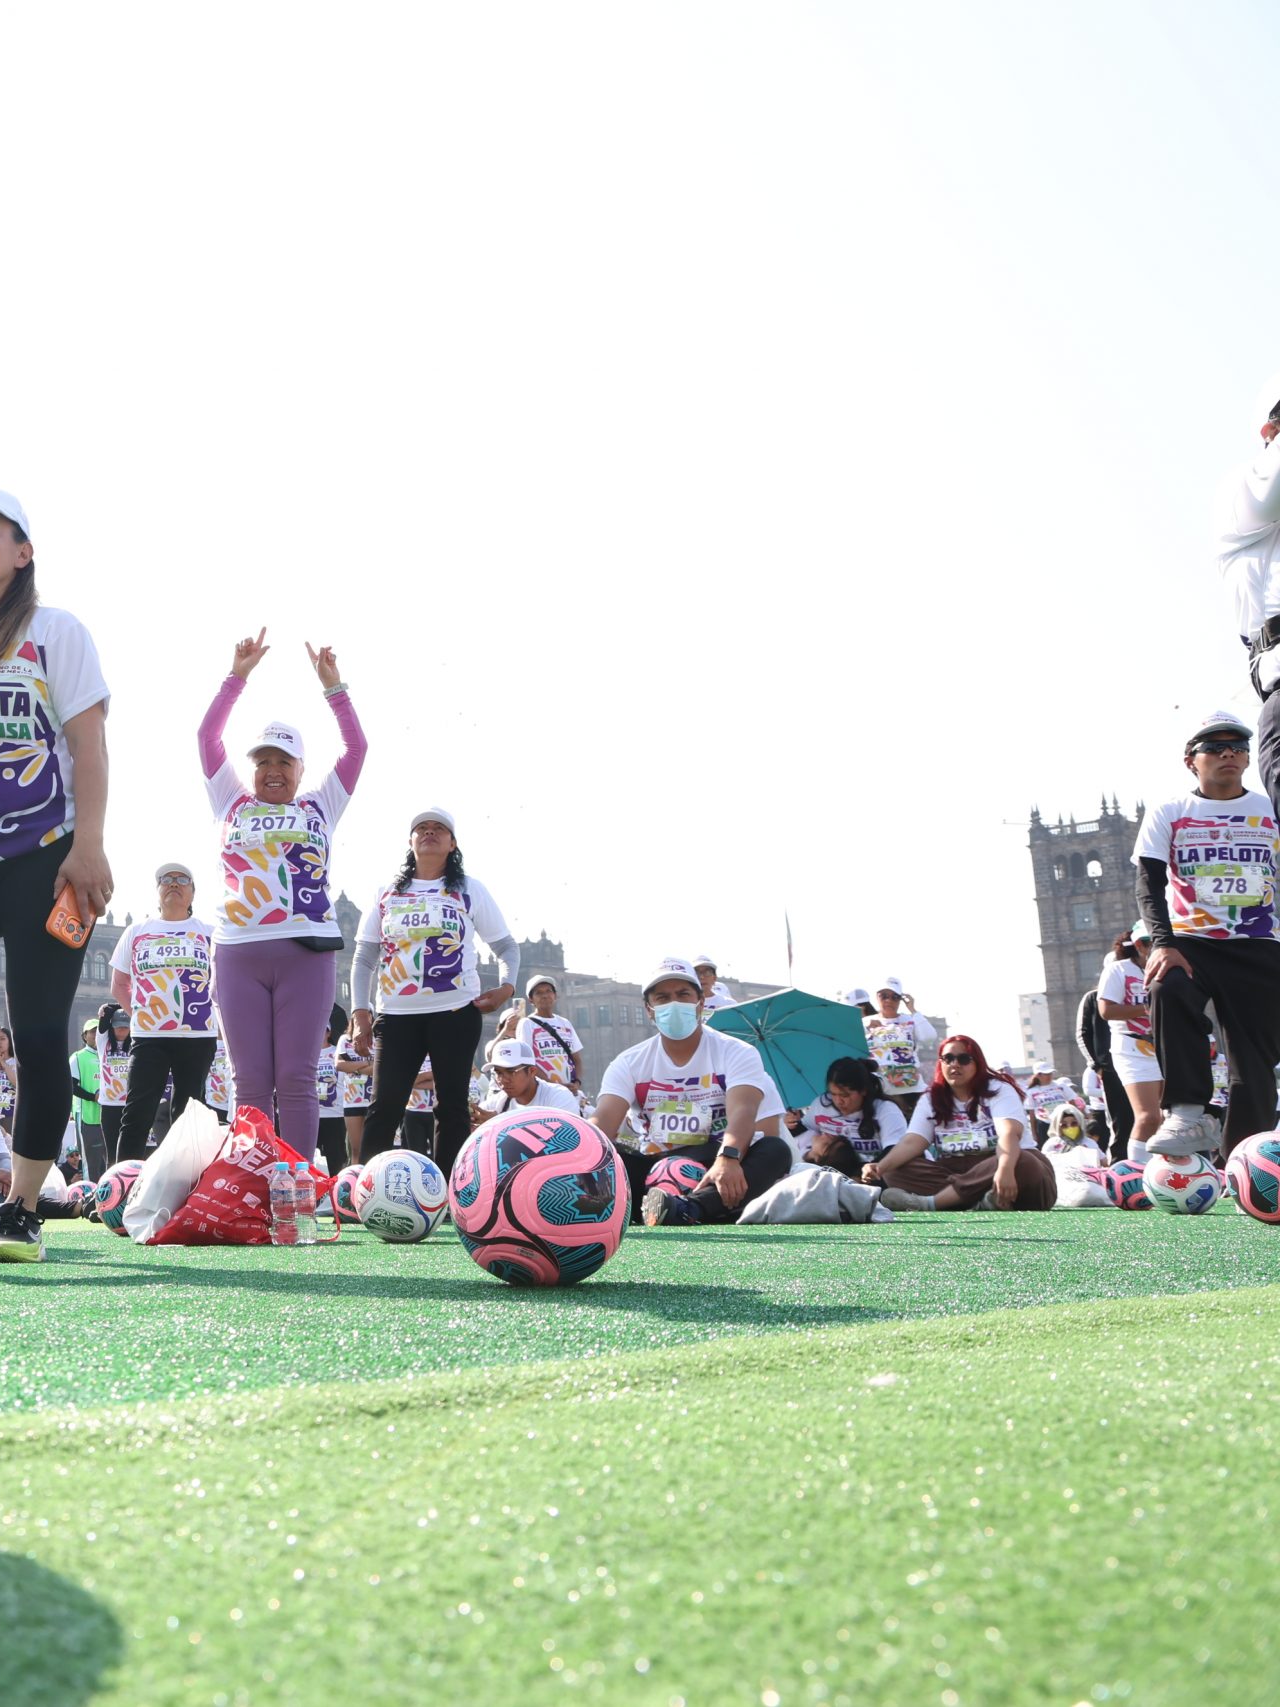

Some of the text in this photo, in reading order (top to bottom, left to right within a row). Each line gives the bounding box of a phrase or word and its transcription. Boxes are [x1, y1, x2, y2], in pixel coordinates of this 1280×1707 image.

[251, 816, 297, 832] 2077
[1177, 847, 1272, 864] LA PELOTA
[1212, 878, 1247, 894] 278
[401, 913, 431, 928] 484
[156, 946, 187, 957] 4931
[539, 1041, 550, 1049] LA
[660, 1115, 700, 1133] 1010
[853, 1141, 880, 1151] OTA
[949, 1141, 980, 1154] 2765
[223, 1180, 240, 1195] LG
